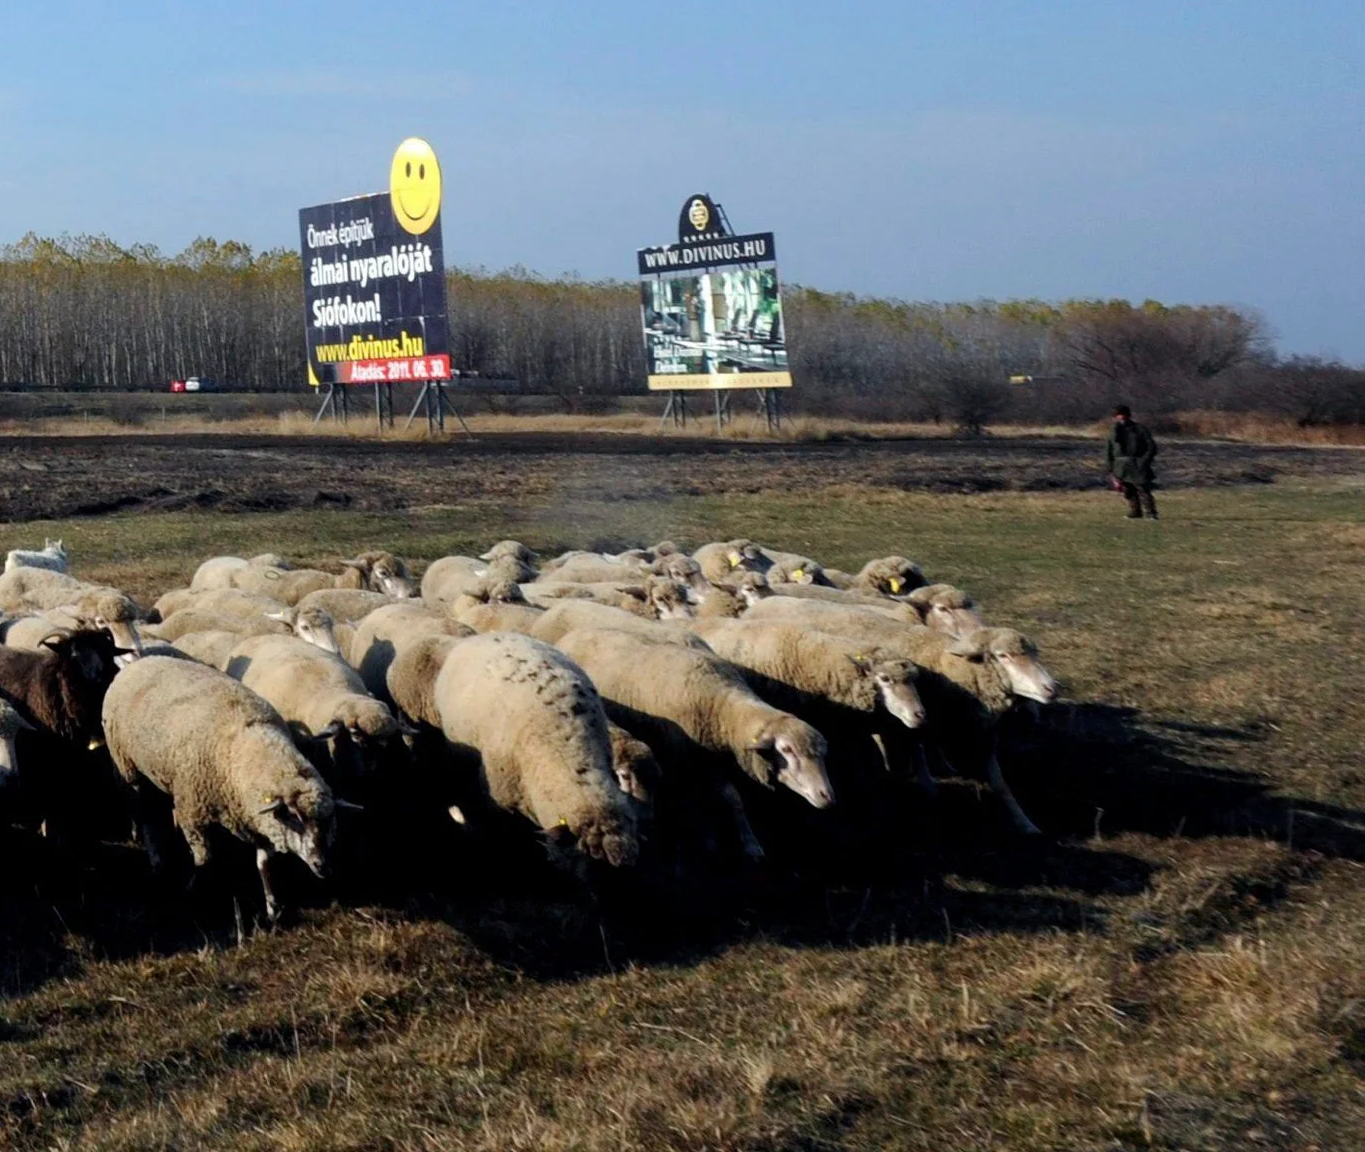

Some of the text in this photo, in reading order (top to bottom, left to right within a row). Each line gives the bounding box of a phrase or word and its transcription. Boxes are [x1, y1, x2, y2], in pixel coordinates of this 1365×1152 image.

[307, 217, 374, 248] Önnek építjük
[310, 242, 433, 288] álmai nyaralóját
[644, 239, 765, 268] WWW.DIVINUS.HU
[312, 292, 382, 327] Siófokon!
[315, 331, 423, 363] www.divinus.hu
